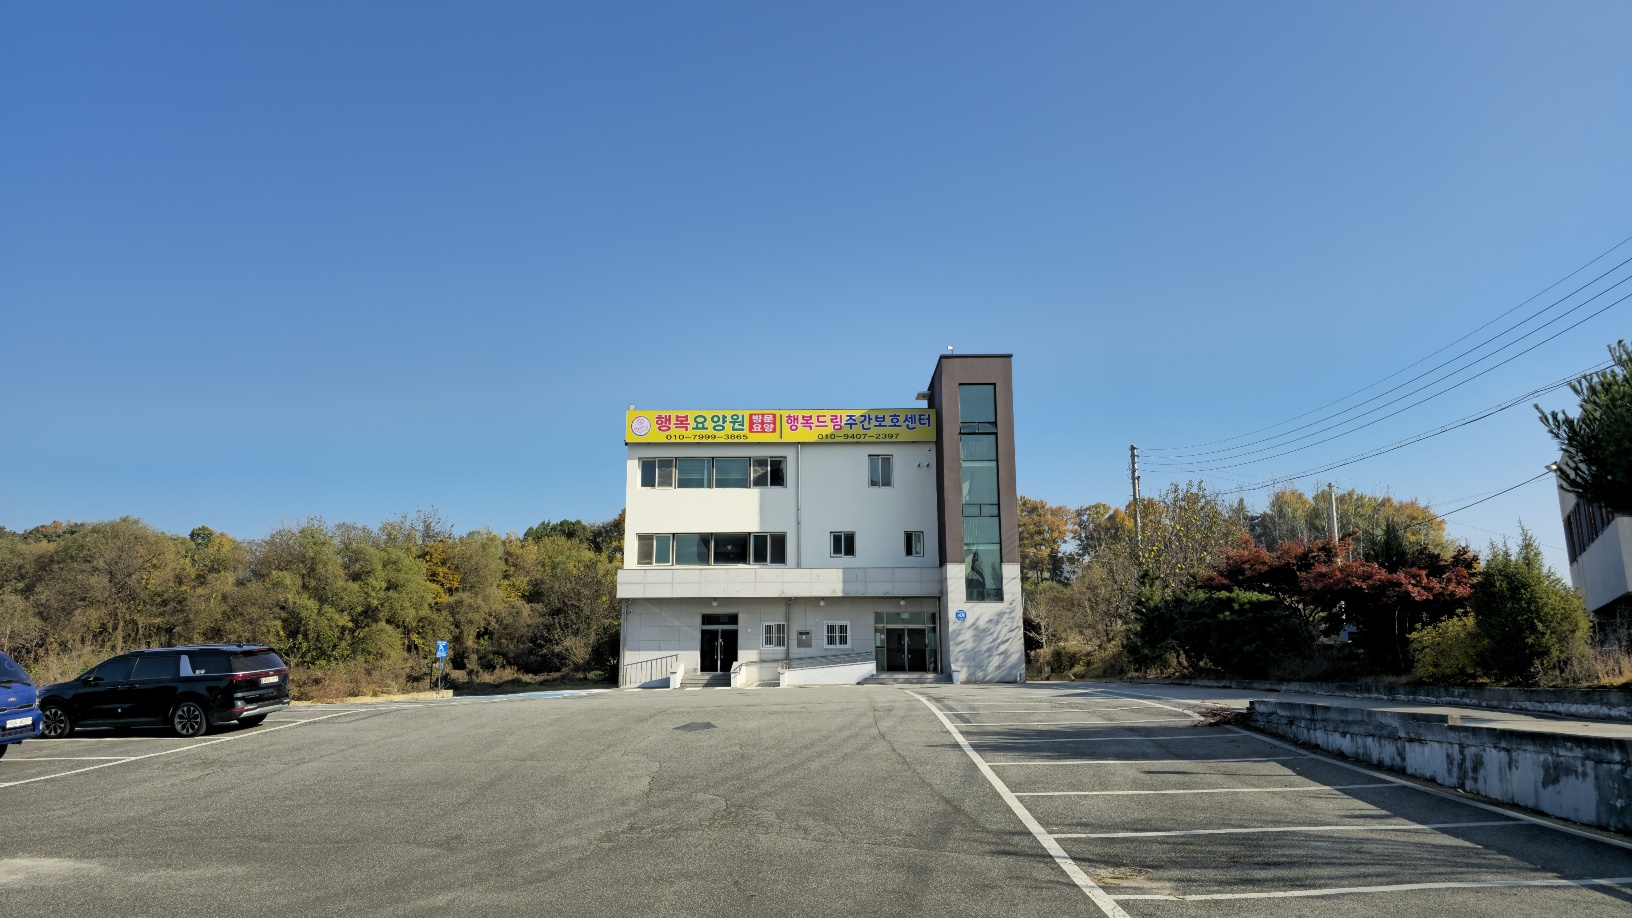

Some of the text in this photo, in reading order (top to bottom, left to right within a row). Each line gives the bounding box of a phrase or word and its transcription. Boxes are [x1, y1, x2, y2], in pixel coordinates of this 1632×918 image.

[655, 413, 745, 432] 행복요양원
[752, 414, 774, 423] 방문
[752, 424, 774, 432] 요양
